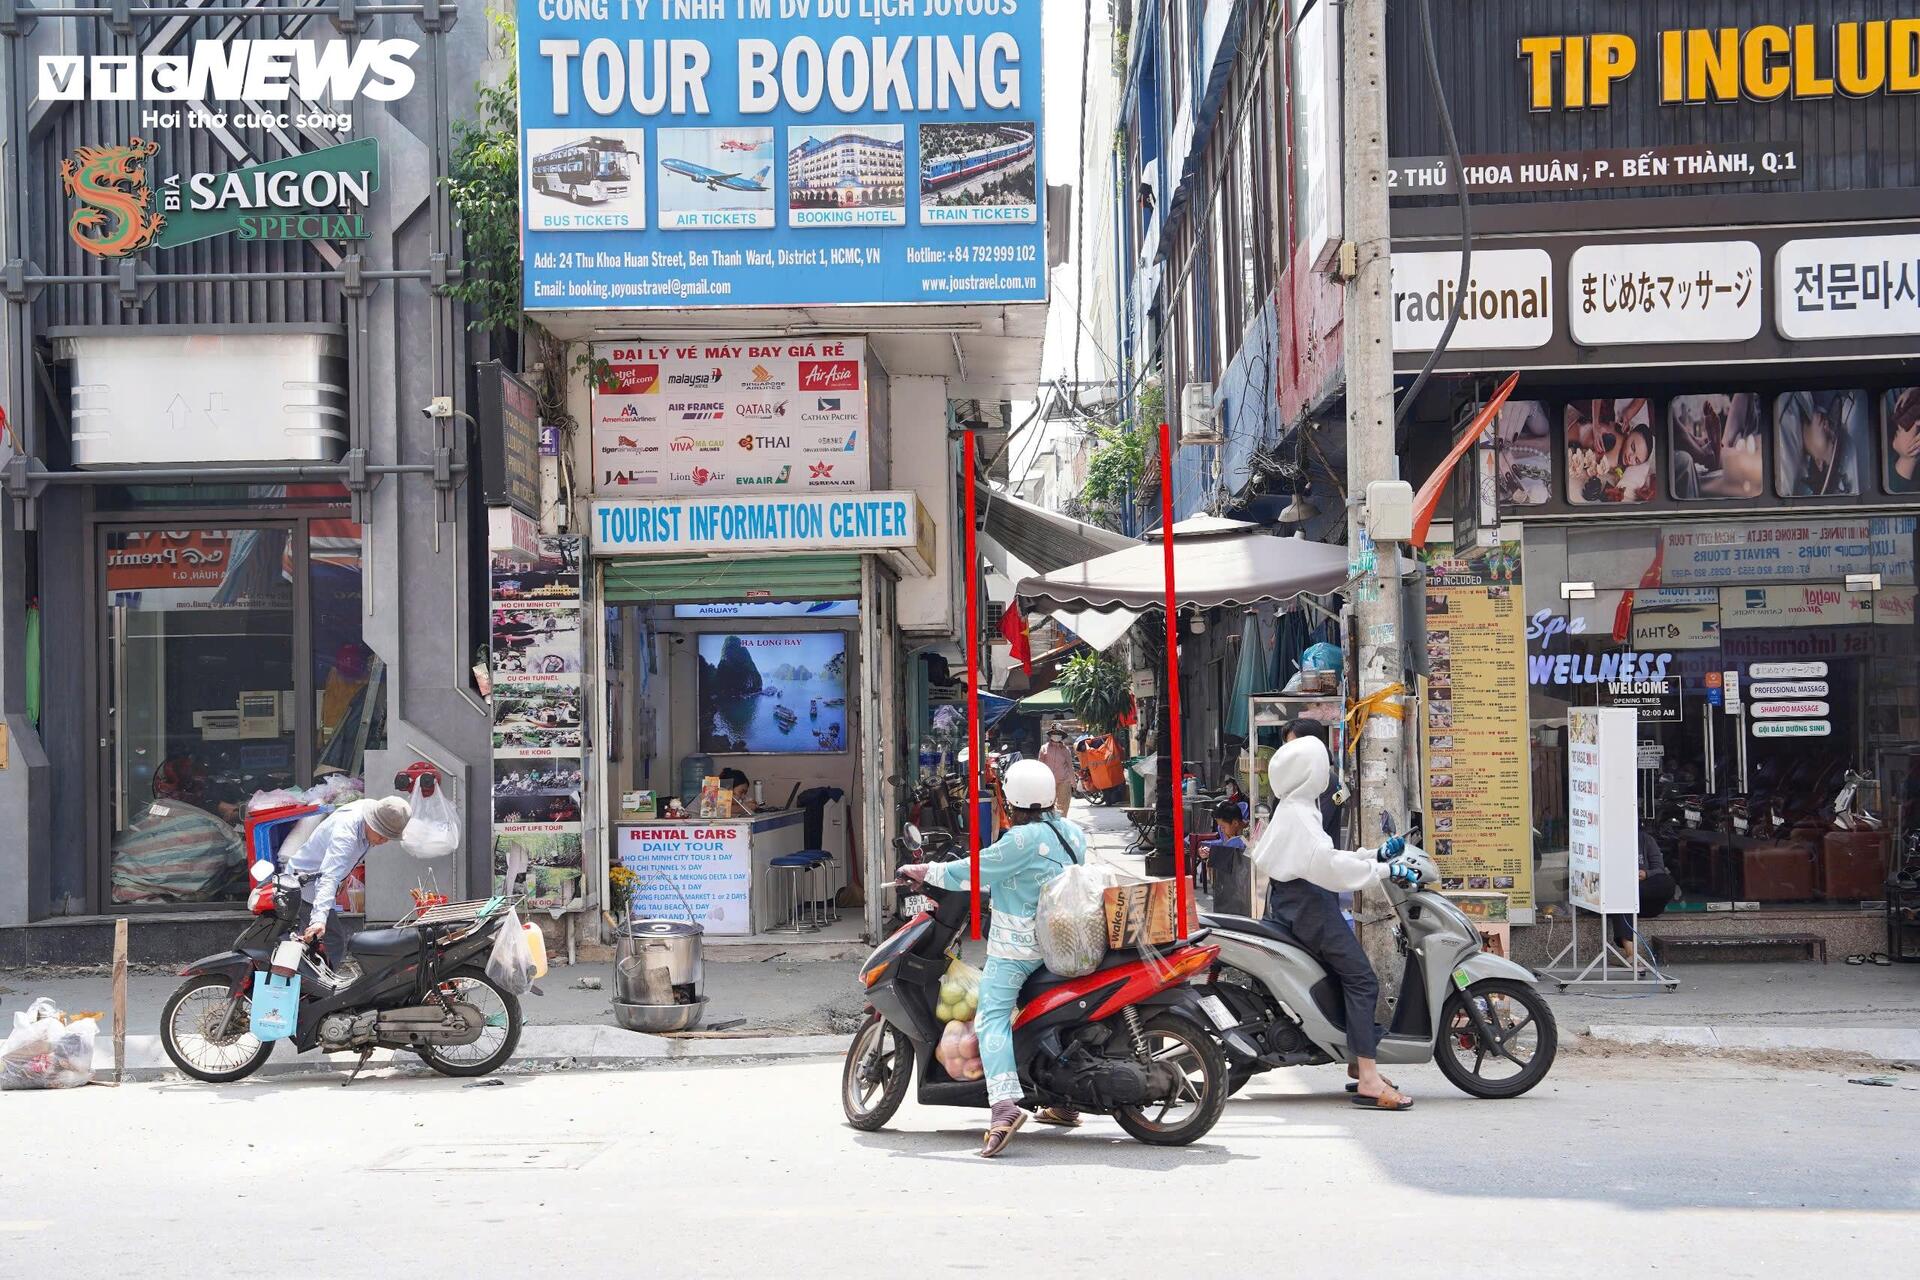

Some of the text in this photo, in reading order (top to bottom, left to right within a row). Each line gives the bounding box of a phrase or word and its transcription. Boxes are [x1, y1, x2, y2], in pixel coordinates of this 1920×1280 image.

[540, 32, 1021, 116] TOUR BOOKING
[1518, 34, 1637, 110] TIP
[1404, 161, 1447, 187] THỦ
[1594, 160, 1615, 178] P.
[1622, 151, 1667, 177] BẾN
[1673, 150, 1754, 175] THÀNH,
[1762, 151, 1797, 173] Q.1
[165, 173, 181, 211] BIA
[189, 170, 370, 211] SAIGON
[544, 214, 629, 226] BUS TICKETS
[676, 213, 757, 225] AIR TICKETS
[797, 210, 897, 223] BOOKING HOTEL
[927, 207, 1030, 220] TRAIN TICKETS
[238, 214, 373, 240] SPECIAL
[534, 247, 881, 269] Add: 24 Thu Khoa Huan Street, Ben Thanh Ward, District 1, HCMC, VN
[906, 247, 946, 263] Hotline:
[948, 246, 969, 262] +84
[534, 278, 731, 299] Email: booking.joyoustravel@gmail.com
[922, 273, 1036, 293] www.joustravel.com.vn
[1581, 267, 1753, 314] まじめなマッサージ
[613, 341, 845, 362] ĐẠI LÝ VÉ MÁY BAY GIÁ RẺ
[667, 373, 710, 388] malaysia
[668, 402, 724, 411] AIR FRANCE
[736, 404, 772, 416] QATAR
[670, 442, 694, 452] VIVA
[756, 436, 790, 448] THAI
[604, 470, 639, 486] JAL
[670, 472, 691, 481] Lion
[710, 472, 726, 481] Air
[736, 476, 773, 485] EVA AIR
[598, 501, 908, 543] TOURIST INFORMATION CENTER
[1430, 576, 1482, 586] TIP INCLUDED
[1526, 608, 1586, 649] Spa
[741, 639, 755, 647] HA
[757, 639, 782, 647] LONG
[1528, 653, 1672, 685] WELLNESS
[1608, 681, 1669, 695] WELCOME
[1754, 685, 1826, 694] PROFESSIONAL MASSAGE
[1642, 709, 1661, 717] 02:00
[1760, 704, 1819, 713] SHAMPOO MASSAGE
[1809, 724, 1825, 732] SINH
[630, 829, 737, 840] RENTAL CARS
[642, 842, 724, 852] DAILY TOUR
